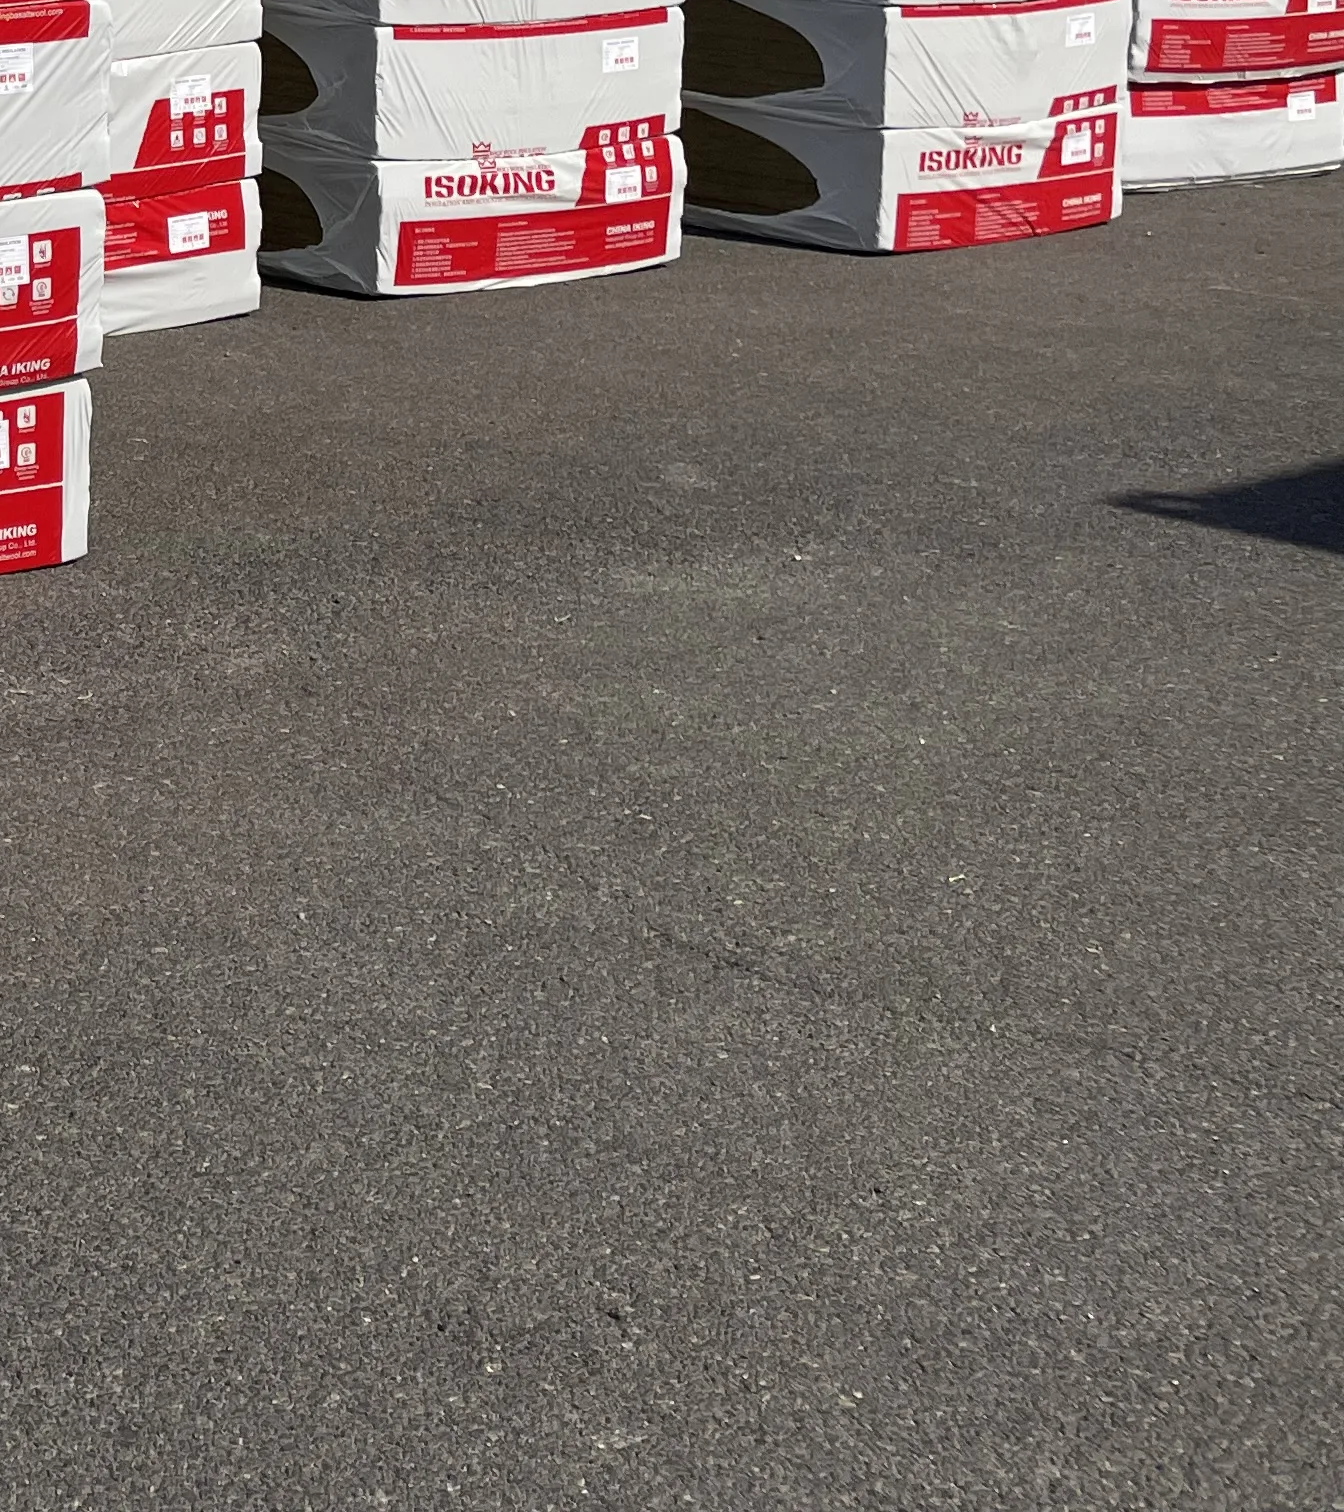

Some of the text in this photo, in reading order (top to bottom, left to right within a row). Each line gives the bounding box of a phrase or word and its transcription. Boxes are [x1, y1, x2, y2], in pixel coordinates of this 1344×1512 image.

[918, 144, 1023, 172] ISOKING
[424, 169, 555, 198] ISOKING
[11, 358, 50, 375] IKING
